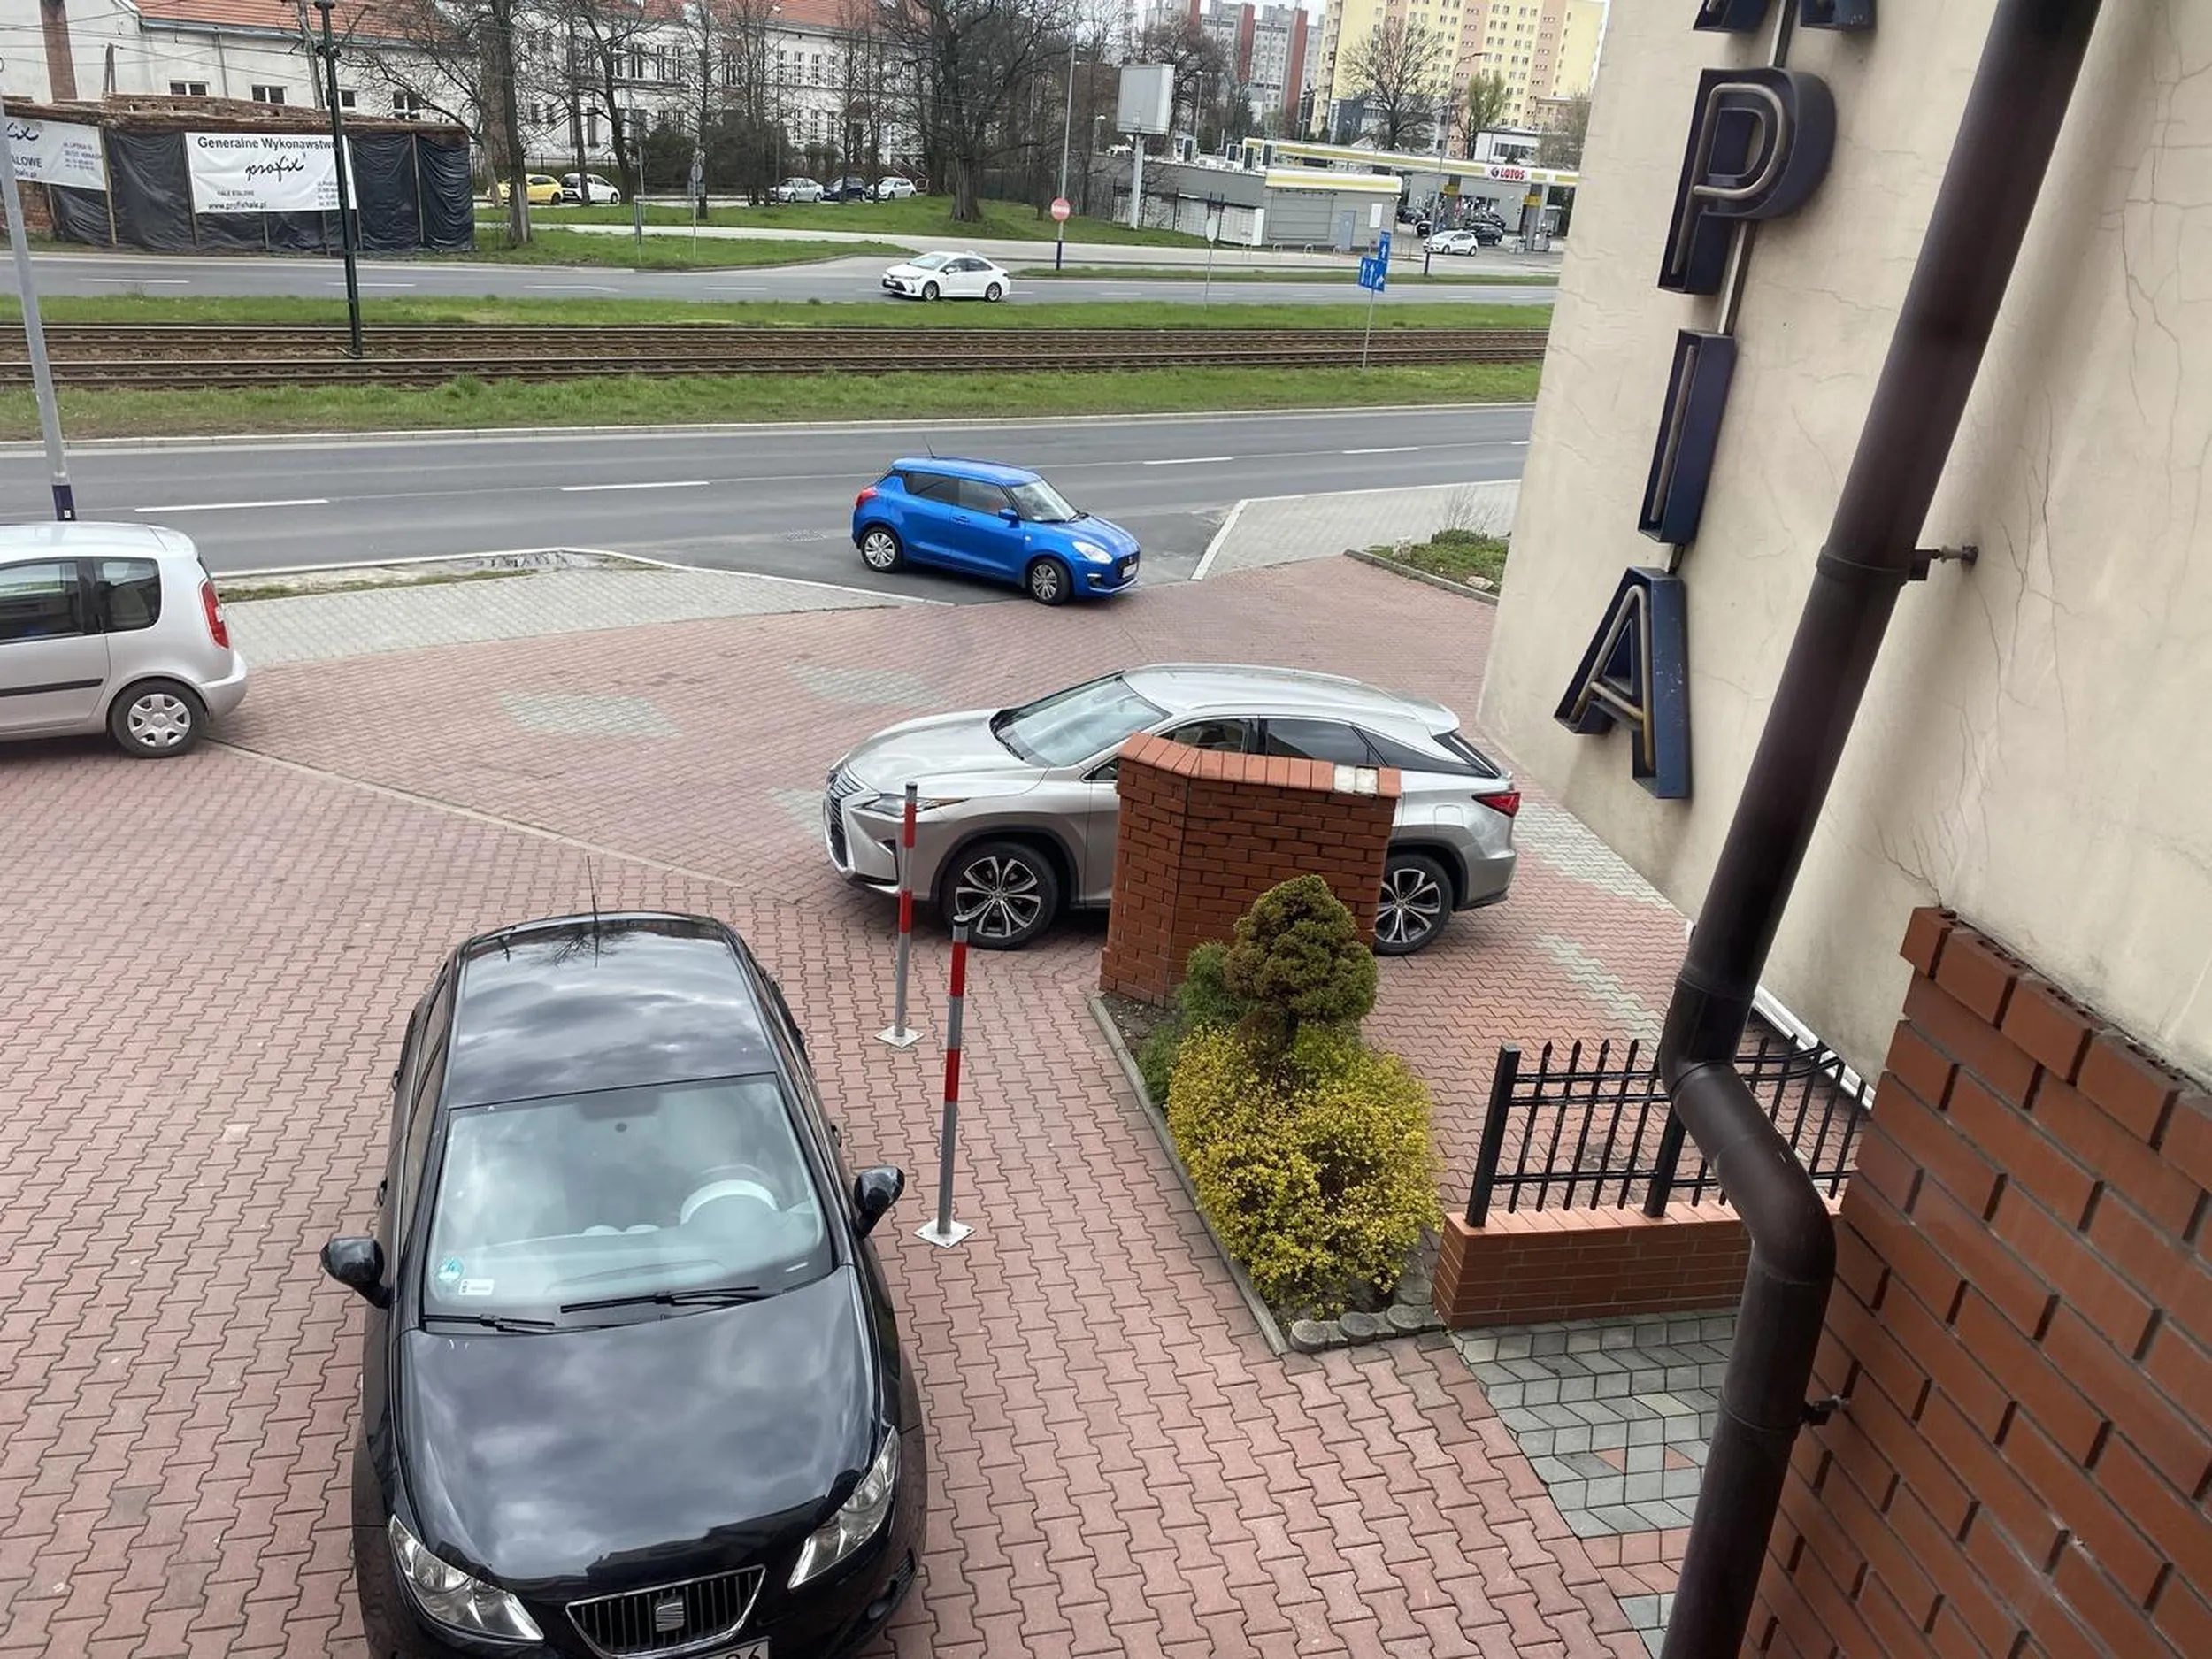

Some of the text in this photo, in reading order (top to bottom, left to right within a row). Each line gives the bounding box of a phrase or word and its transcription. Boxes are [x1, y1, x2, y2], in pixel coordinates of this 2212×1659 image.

[197, 135, 259, 149] Generalne
[1500, 168, 1525, 180] LOTOS
[1555, 0, 1877, 800] PIA
